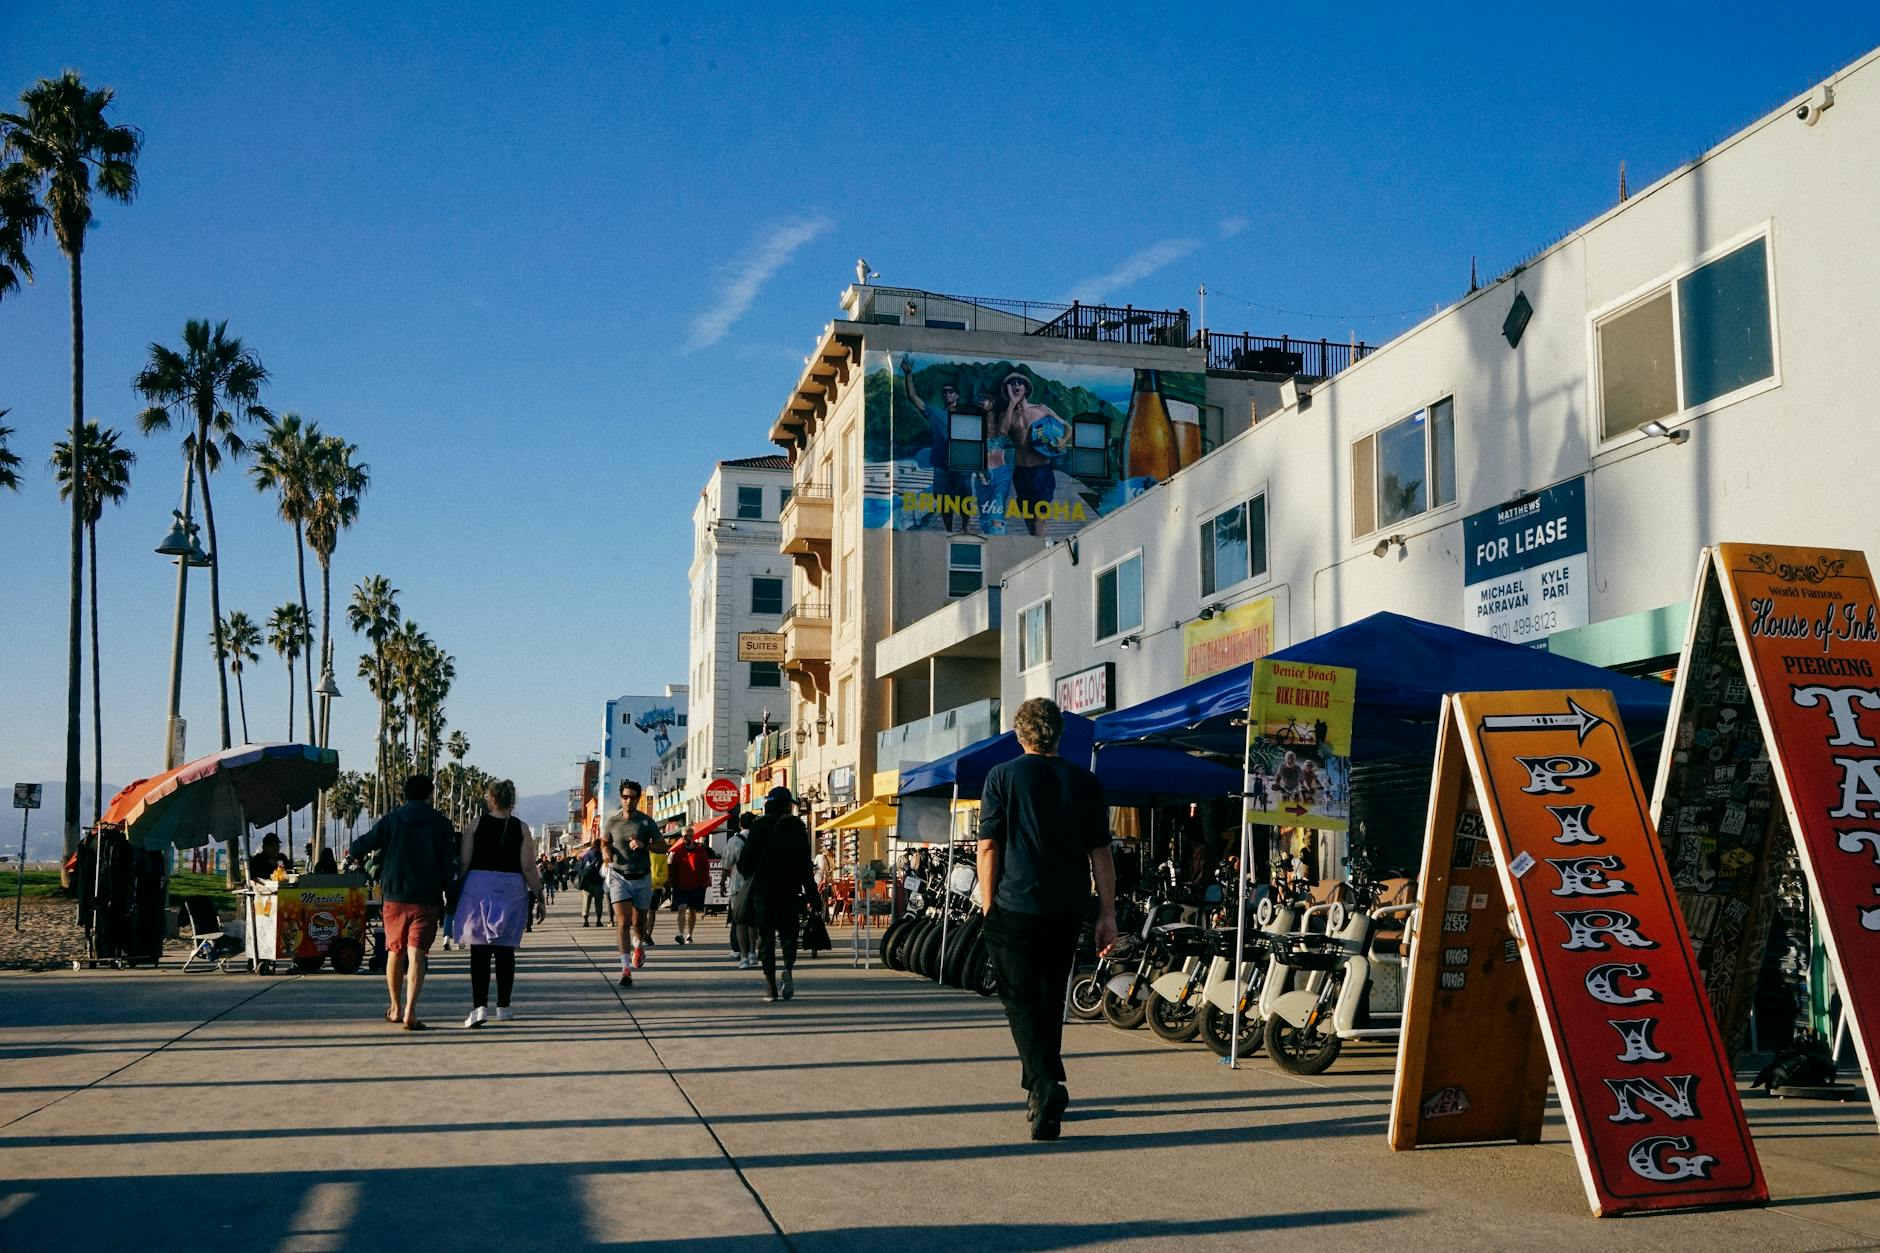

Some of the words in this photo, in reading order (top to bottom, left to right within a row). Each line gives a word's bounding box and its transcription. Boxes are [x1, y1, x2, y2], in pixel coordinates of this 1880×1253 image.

[903, 491, 977, 516] BRING
[981, 500, 1004, 514] the
[1006, 500, 1087, 521] ALOHA
[1497, 498, 1541, 522] MATTHEWS
[1476, 536, 1509, 567] FOR
[1515, 516, 1568, 554] LEASE
[1541, 566, 1569, 585] KYLE
[1480, 580, 1524, 601] MICHAEL
[1542, 582, 1569, 601] PARI
[1768, 585, 1800, 598] World
[1801, 588, 1843, 600] Famous
[1477, 593, 1529, 618] PAKRAVAN
[1513, 610, 1557, 636] 499-8123
[1751, 598, 1809, 639] House
[1814, 602, 1836, 653] of
[1836, 602, 1880, 643] Ink
[1783, 656, 1874, 677] PIERCING
[1057, 677, 1083, 712] VENICE
[1084, 671, 1105, 706] LOVE
[1276, 686, 1294, 705] BIKE
[1295, 688, 1330, 709] RENTALS
[1513, 755, 1719, 1182] PIERCING
